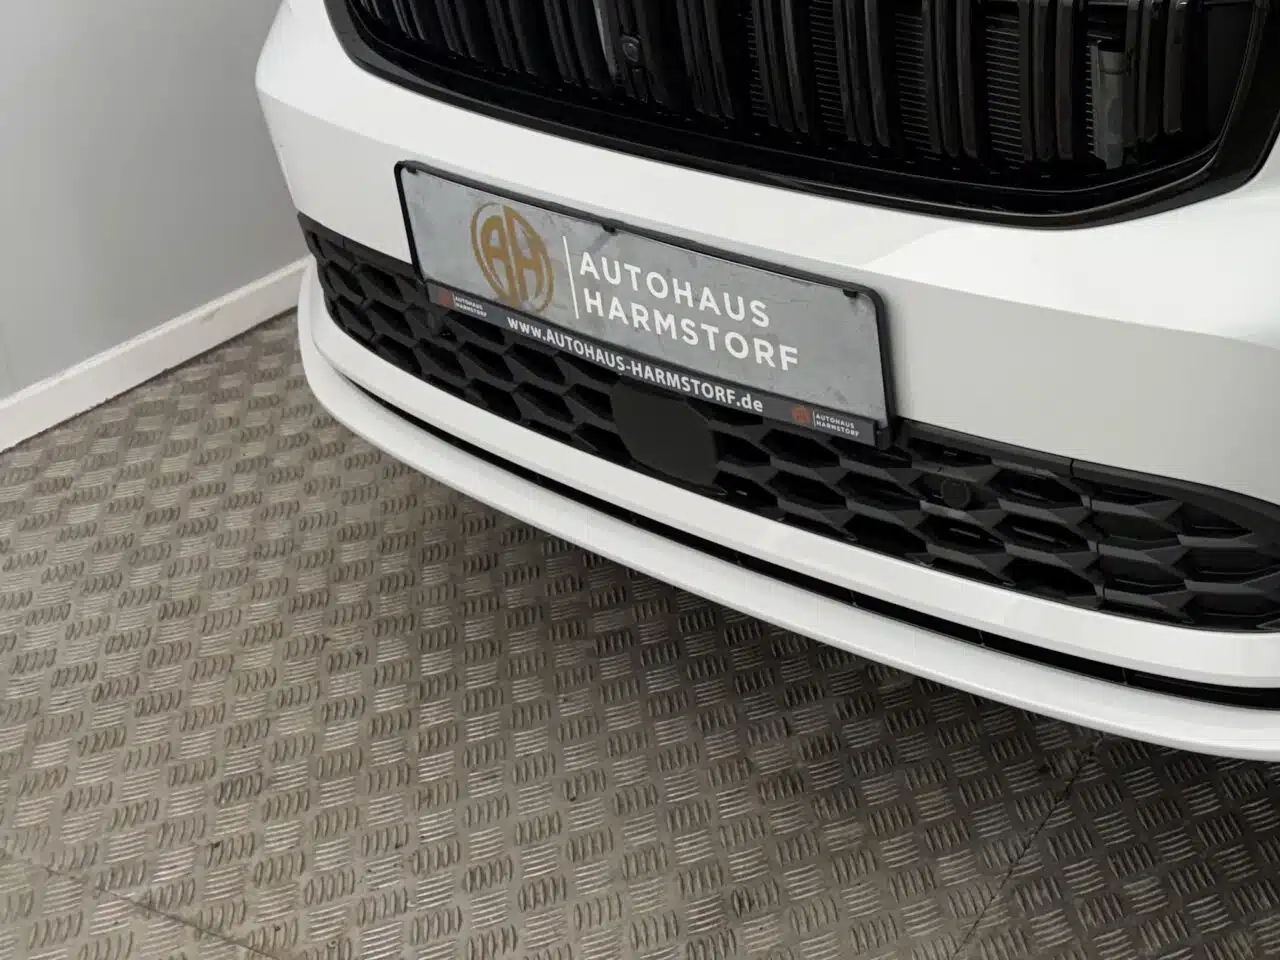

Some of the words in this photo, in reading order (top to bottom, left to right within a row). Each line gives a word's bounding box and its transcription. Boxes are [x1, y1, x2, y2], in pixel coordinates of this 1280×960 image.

[580, 251, 769, 328] AUTOHAUS
[583, 287, 798, 371] HARMSTORF
[507, 316, 763, 413] www.AUTOHAUS-HARMSTORF.de
[816, 413, 854, 429] AUTOHAUS
